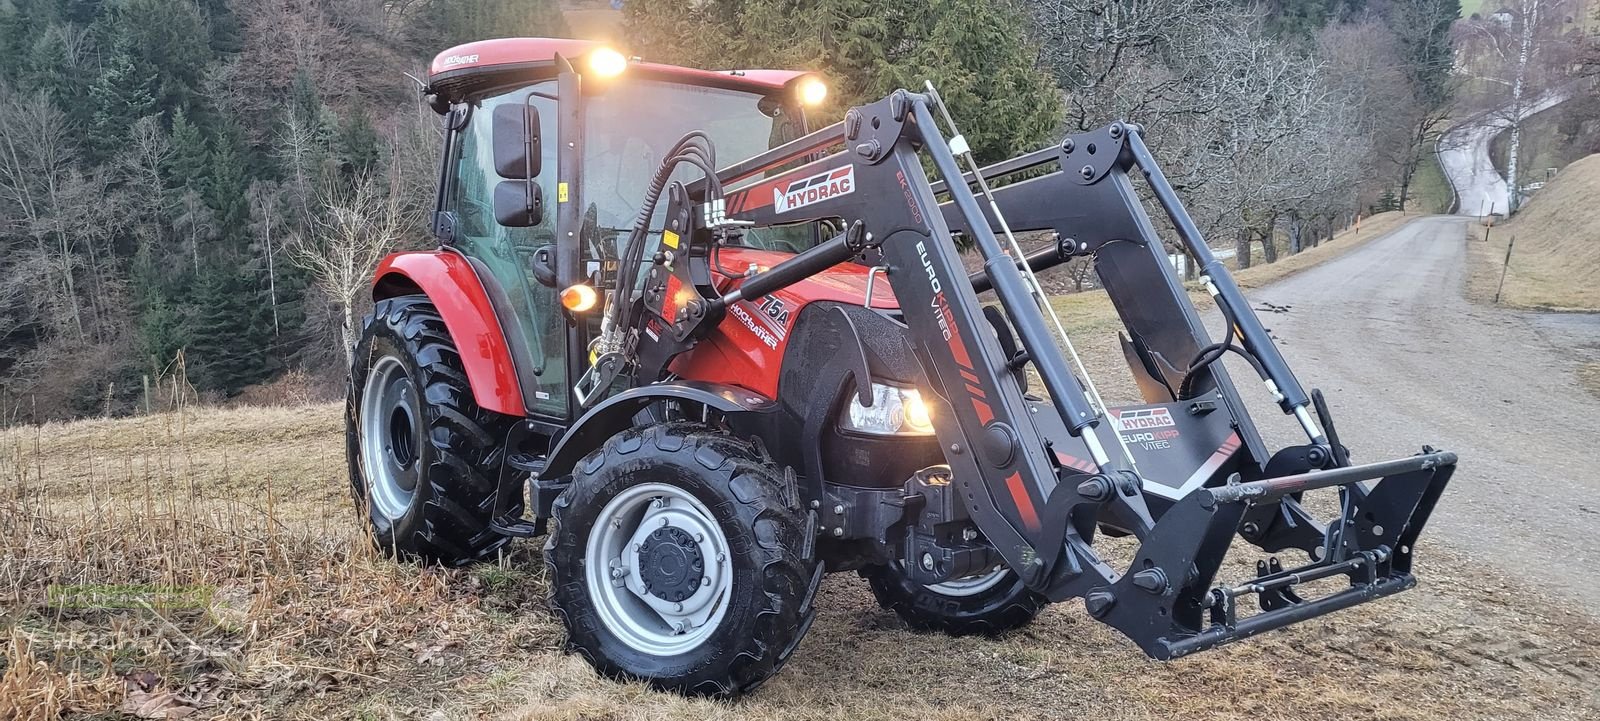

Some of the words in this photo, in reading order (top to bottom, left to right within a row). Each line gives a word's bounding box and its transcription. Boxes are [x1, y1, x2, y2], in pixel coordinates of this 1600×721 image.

[786, 178, 851, 209] HYDRAC
[904, 190, 922, 224] 2000
[759, 294, 789, 325] 75A
[730, 303, 778, 351] HOCHRATHER
[1122, 416, 1171, 429] HYDRAC
